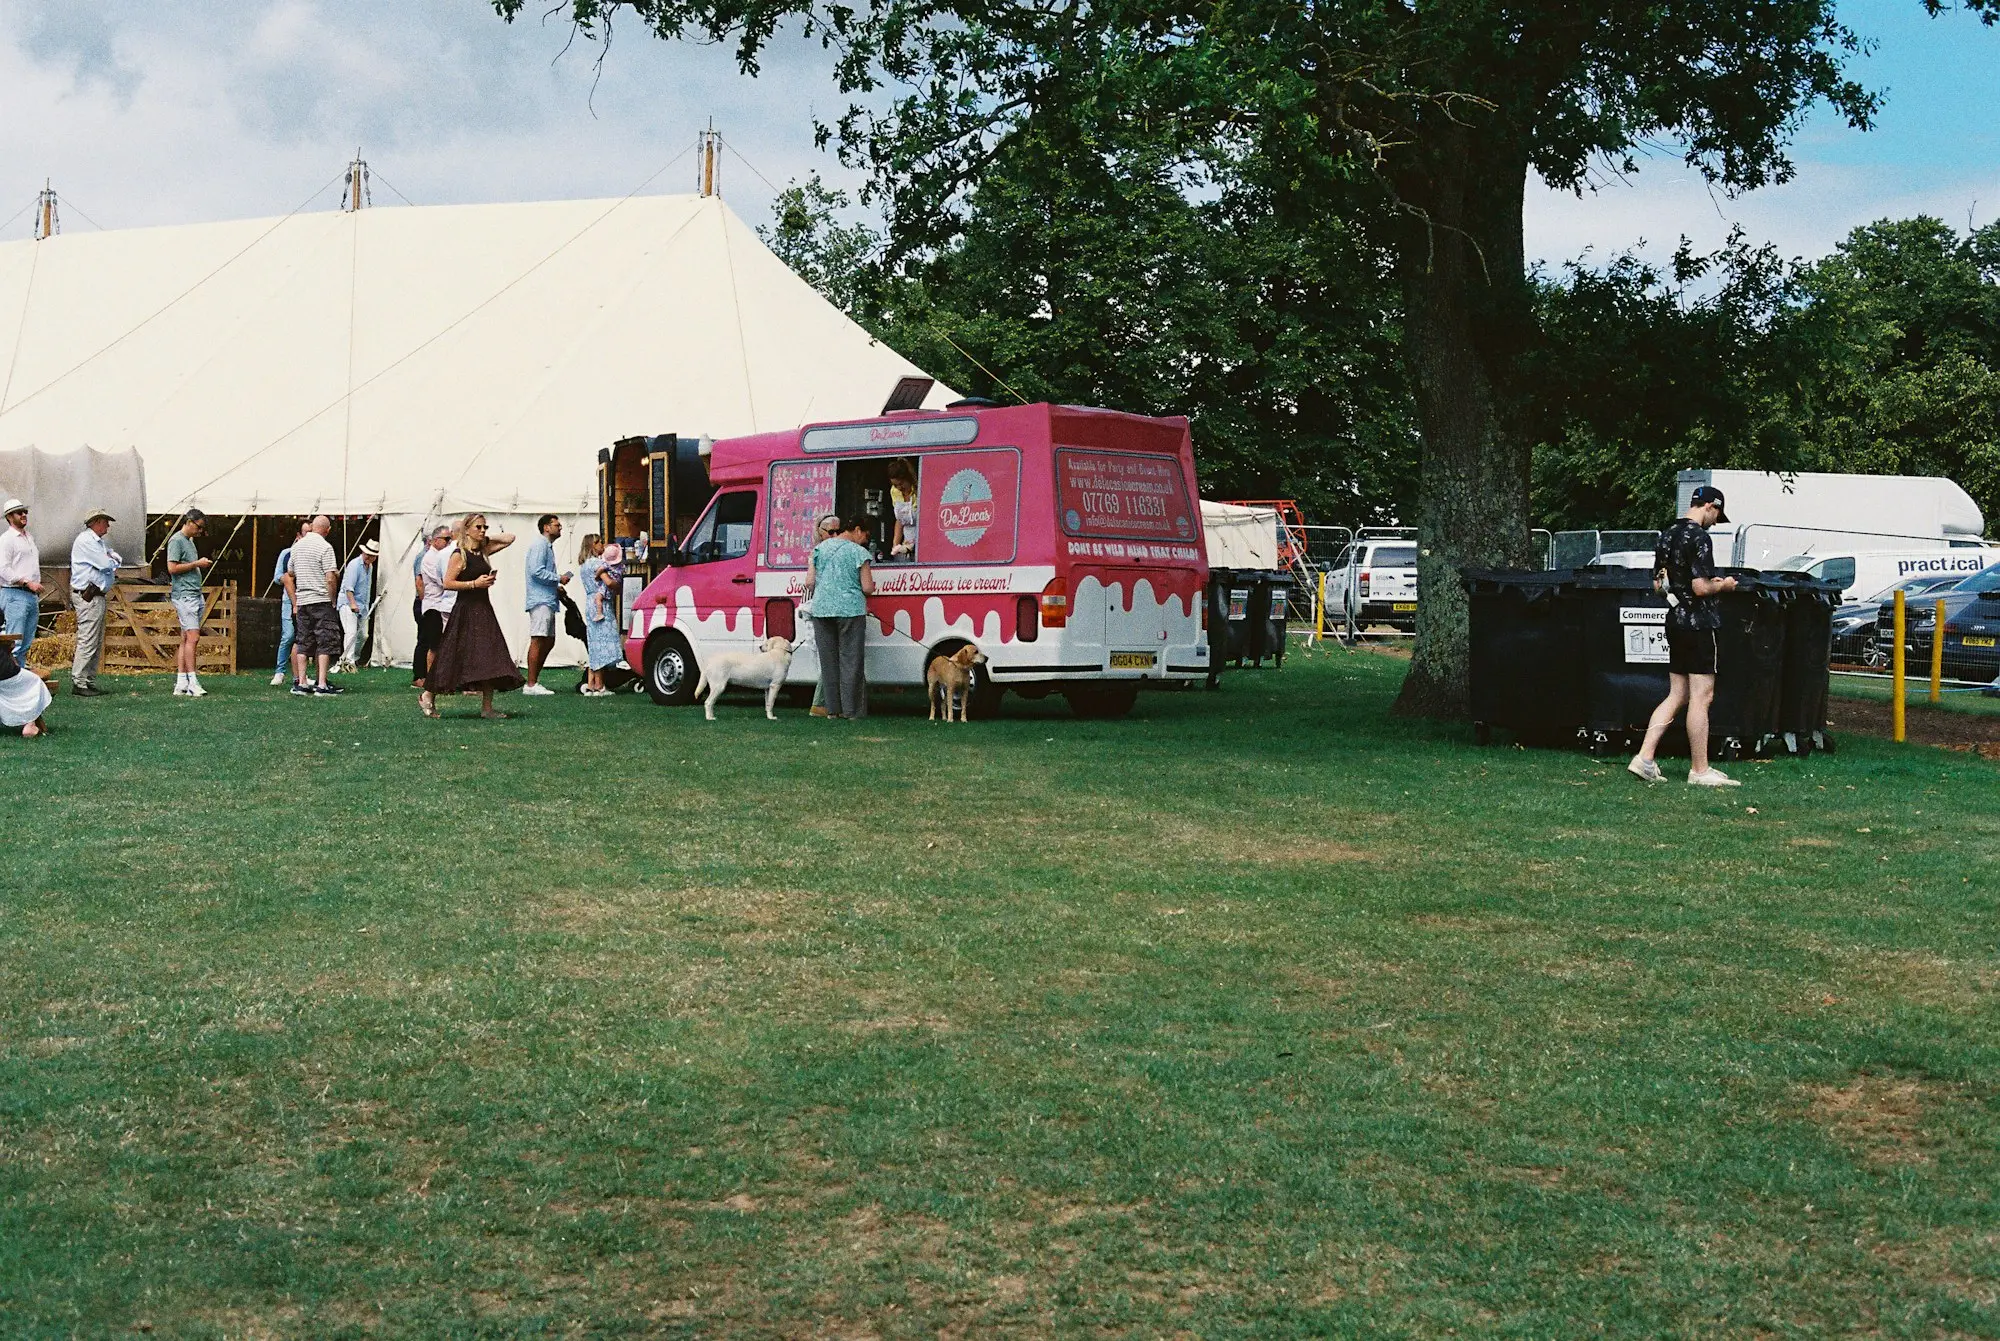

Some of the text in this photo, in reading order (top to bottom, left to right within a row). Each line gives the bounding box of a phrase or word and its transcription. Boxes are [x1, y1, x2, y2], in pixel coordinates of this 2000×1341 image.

[1082, 491, 1167, 517] 07769 116331
[1092, 543, 1104, 556] BE
[1104, 543, 1125, 557] WILD
[1126, 544, 1149, 559] MIND
[1150, 546, 1171, 560] THAT
[1171, 547, 1199, 561] CHILD!
[1898, 555, 1984, 576] practical
[882, 572, 906, 592] with
[909, 571, 953, 592] Delucas
[957, 576, 973, 591] ice
[974, 572, 1013, 591] cream!
[1622, 610, 1667, 620] Commerc
